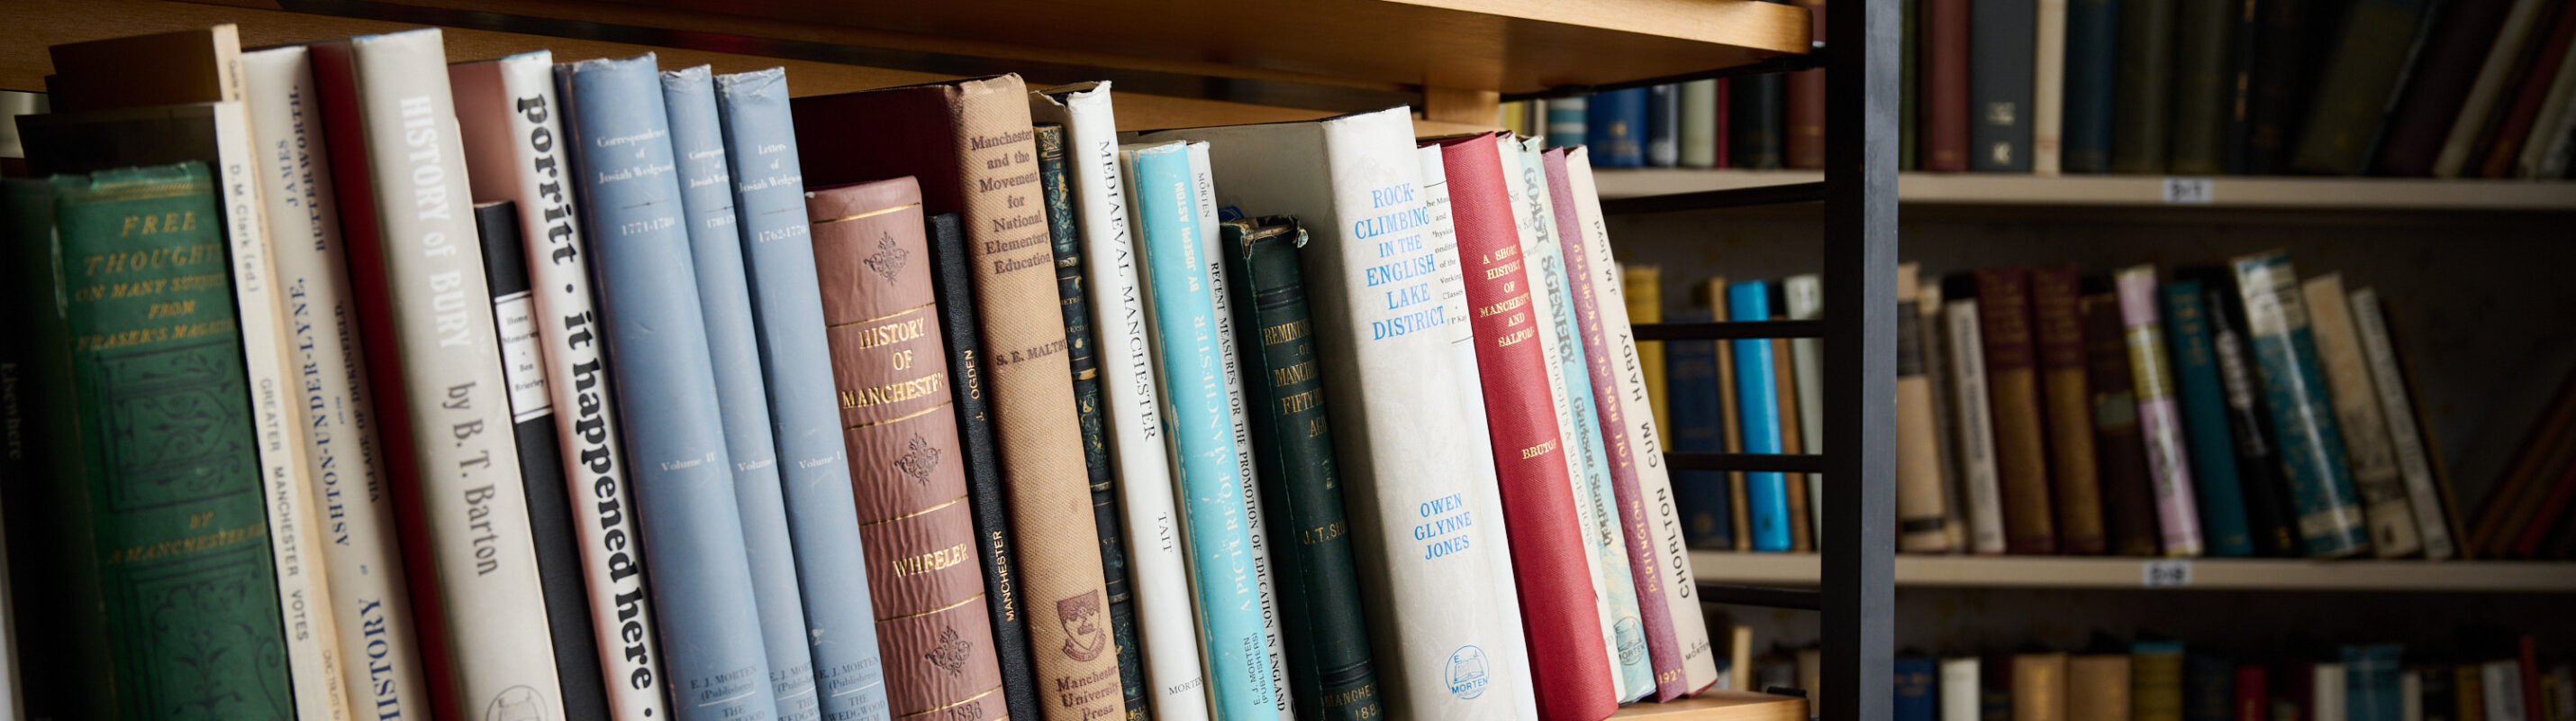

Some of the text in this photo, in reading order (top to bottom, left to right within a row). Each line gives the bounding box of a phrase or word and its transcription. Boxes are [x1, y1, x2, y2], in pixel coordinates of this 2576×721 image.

[757, 143, 787, 156] Letters
[969, 130, 1034, 151] Manchester
[276, 139, 299, 207] JAMES
[986, 151, 1031, 169] and the
[598, 168, 632, 185] Josiah
[739, 178, 768, 194] Josiah
[978, 170, 1039, 194] Movement
[1006, 195, 1025, 210] for
[1197, 172, 1211, 219] MORTEN
[1372, 182, 1415, 209] ROCK-
[121, 211, 197, 236] FREE
[400, 95, 472, 349] HISTORY of BURY
[992, 210, 1043, 233] National
[1354, 206, 1430, 240] CLIMBING
[984, 231, 1050, 256] Elementary
[1174, 181, 1201, 293] BY JOSEPH ASTON
[1378, 234, 1423, 258] IN THE
[993, 252, 1052, 275] Education
[1365, 253, 1437, 287] ENGLISH
[1483, 253, 1491, 264] A
[1523, 166, 1550, 244] COAST
[1540, 254, 1576, 366] SCENERY
[111, 278, 168, 299] MANY
[1099, 139, 1157, 443] MEDIAEVAL MANCHESTER
[1387, 283, 1431, 310] LAKE
[1503, 280, 1515, 294] OF
[148, 299, 196, 320] FROM
[1508, 312, 1526, 327] AND
[858, 317, 925, 350] HISTORY
[1372, 306, 1446, 341] DISTRICT
[893, 349, 913, 370] OF
[1598, 355, 1609, 377] OF
[963, 350, 981, 400] OGDEN
[517, 93, 653, 691] porritt it happened here
[1282, 390, 1315, 415] FIFTY
[1605, 385, 1619, 423] BARS
[1548, 344, 1594, 545] THOUGHTS & SUGGESTIONS
[1615, 434, 1629, 470] TOLL
[1640, 421, 1657, 469] CUM
[660, 452, 716, 473] Volume II
[737, 457, 773, 473] Volume
[798, 454, 835, 470] Volume
[1193, 315, 1253, 613] A PICTURE OF MANCHESTER
[1573, 397, 1613, 547] Clarkson Stanfield
[441, 380, 501, 578] by B. T. Barton
[1211, 261, 1285, 711] RECENT MEASURES FOR THE PROMOTION OF EDUCATION IN ENGLAND
[259, 378, 310, 643] GREATER MANCHESTER VOTES
[1420, 492, 1464, 518] OWEN
[1157, 511, 1173, 552] TAIT
[1414, 511, 1473, 541] GLYNNE
[1424, 534, 1470, 561] JONES
[1655, 487, 1691, 599] CHORLTON
[893, 542, 970, 580] WHEELER
[992, 530, 1017, 624] MANCHESTER
[841, 656, 880, 676] MORTEN
[1243, 636, 1257, 684] MORTEN
[1251, 632, 1269, 704] (PUBLISHERS)
[1454, 654, 1460, 663] E
[714, 664, 757, 685] MORTEN
[1055, 663, 1118, 693] Manchester
[1451, 677, 1489, 695] MORTEN
[848, 694, 869, 707] THE
[1061, 682, 1120, 708] University
[721, 704, 744, 718] THE
[1081, 703, 1114, 721] Press
